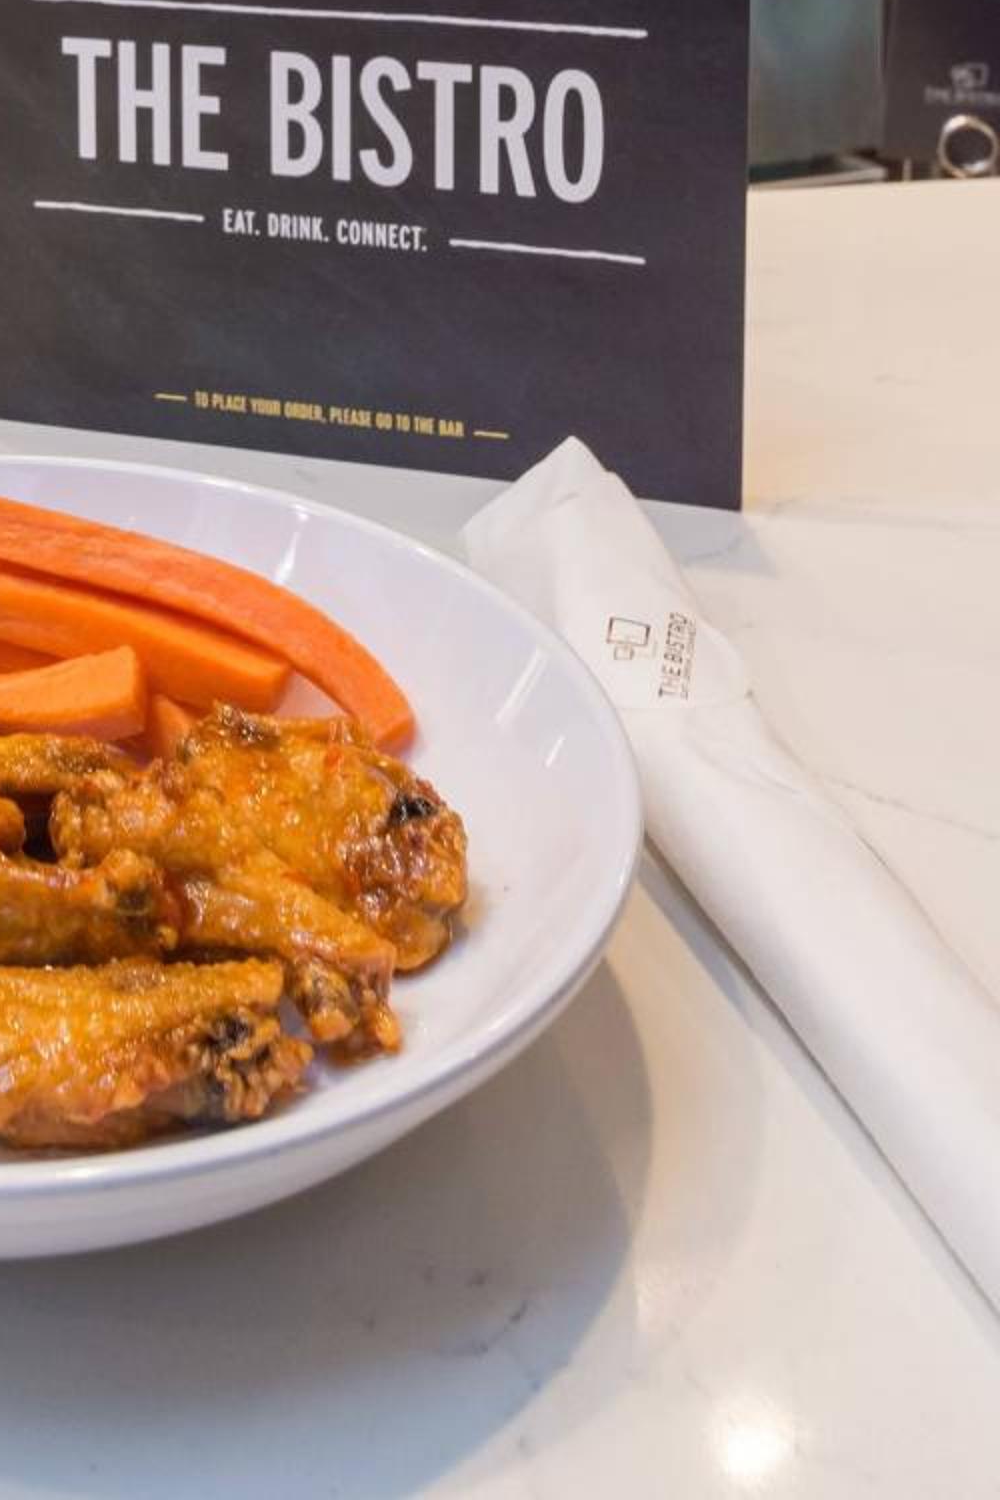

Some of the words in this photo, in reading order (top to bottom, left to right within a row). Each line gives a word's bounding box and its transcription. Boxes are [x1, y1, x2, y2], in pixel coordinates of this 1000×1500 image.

[61, 36, 229, 171] THE
[270, 50, 604, 203] BISTRO
[223, 208, 260, 236] EAT.
[267, 212, 330, 242] DRINK.
[336, 219, 428, 252] CONNECT.
[195, 391, 209, 408] TO
[212, 393, 247, 413] PLACE
[250, 397, 281, 416] YOUR
[329, 406, 372, 428] PLEASE
[375, 412, 393, 430] GO
[396, 414, 410, 432] TO
[413, 416, 434, 435] THE
[438, 419, 464, 437] BAR
